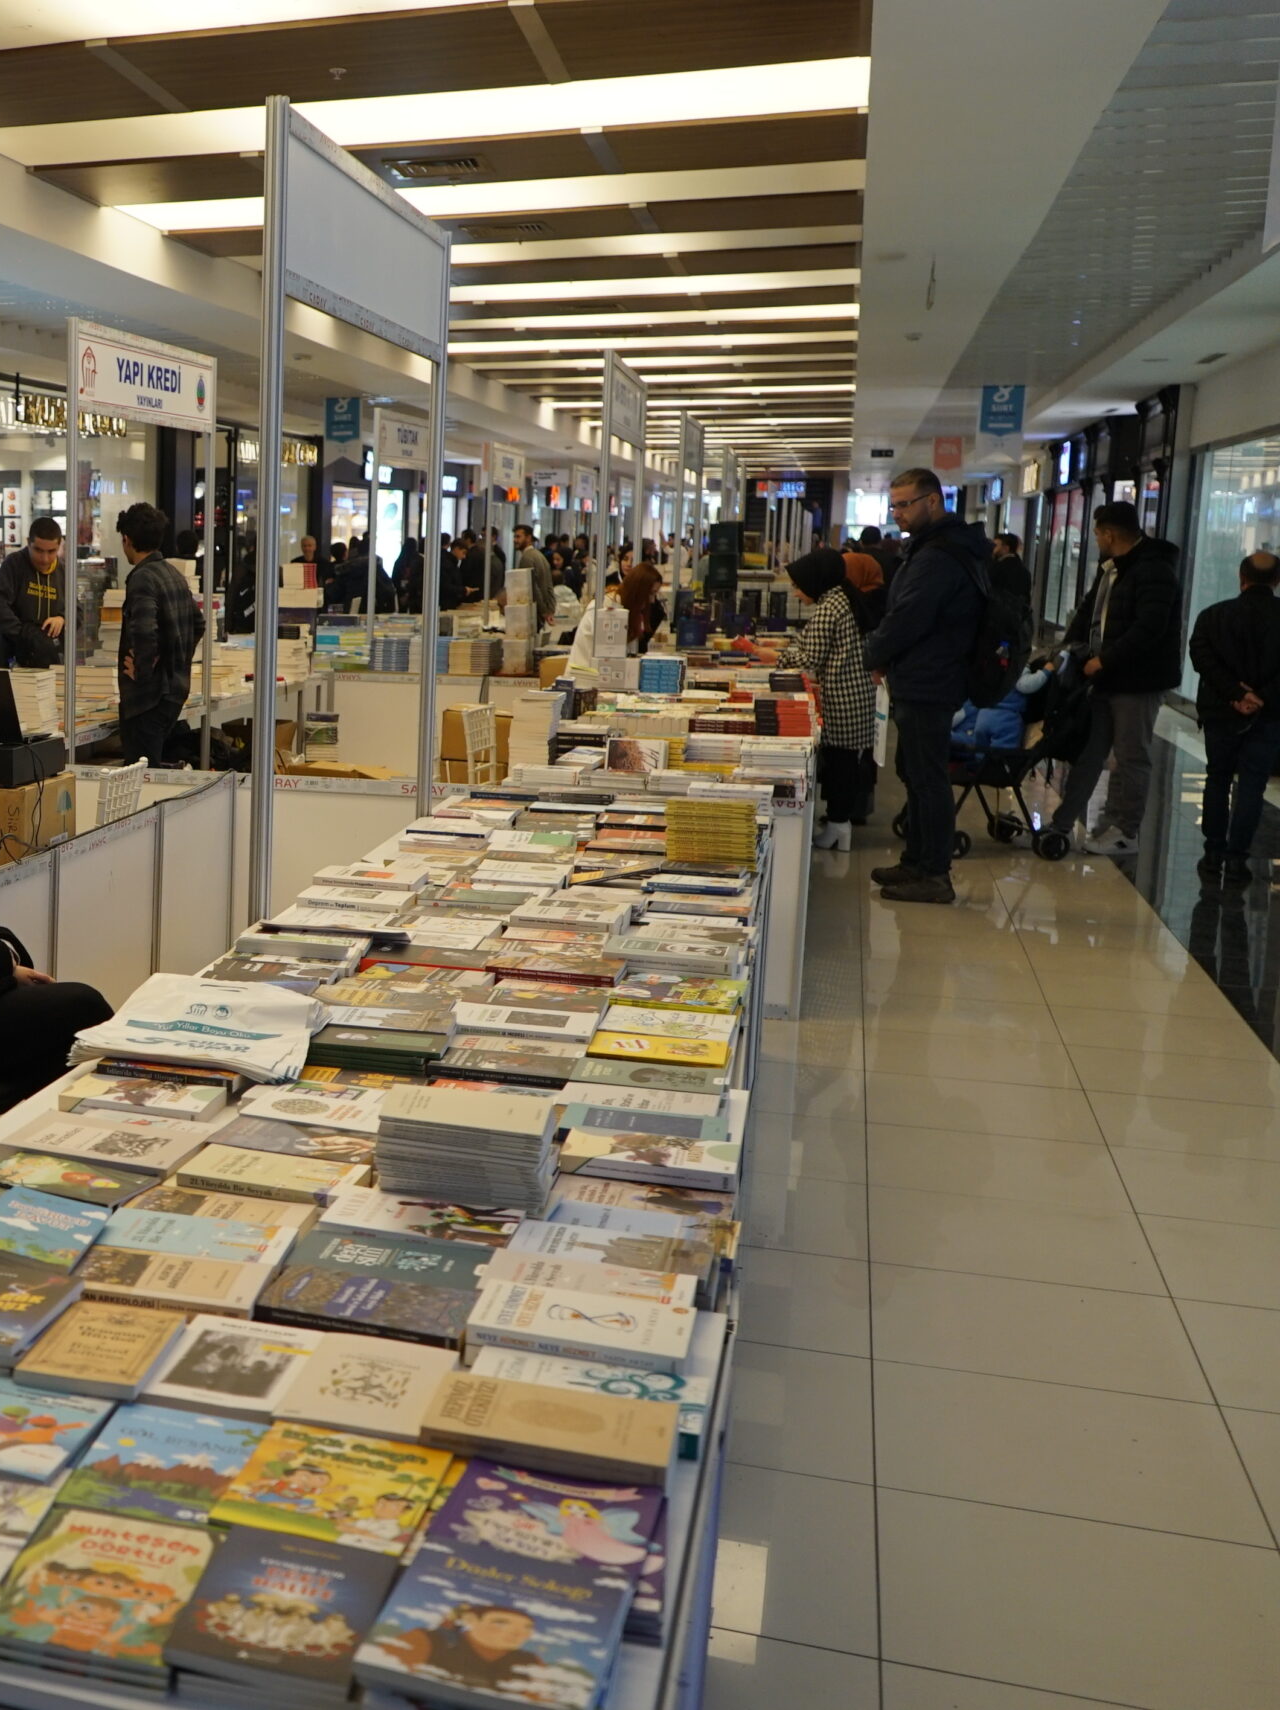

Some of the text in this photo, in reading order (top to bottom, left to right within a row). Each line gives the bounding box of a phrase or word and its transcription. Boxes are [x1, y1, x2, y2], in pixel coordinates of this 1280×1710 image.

[117, 356, 181, 395] YAPI KREDİ
[136, 394, 163, 410] YAYINLARI
[275, 778, 301, 789] RAY
[307, 899, 329, 907] Deprem
[335, 901, 356, 909] Toplum
